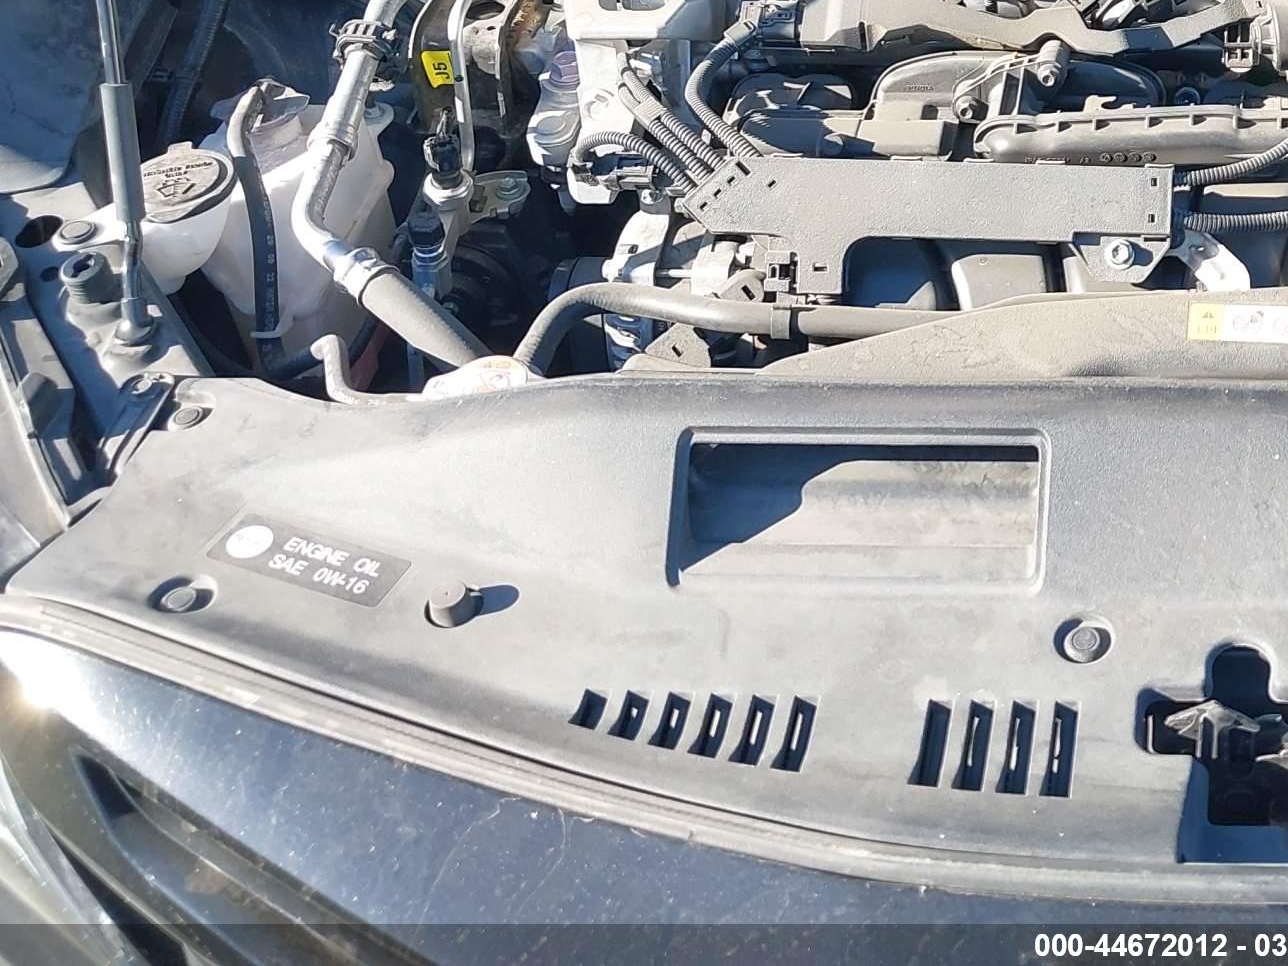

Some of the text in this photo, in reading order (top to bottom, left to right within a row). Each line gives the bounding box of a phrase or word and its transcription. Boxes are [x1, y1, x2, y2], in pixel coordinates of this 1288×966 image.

[432, 62, 450, 79] J5
[268, 553, 370, 594] SAE 0W-16
[283, 537, 349, 566] ENGINE
[353, 557, 381, 578] OIL
